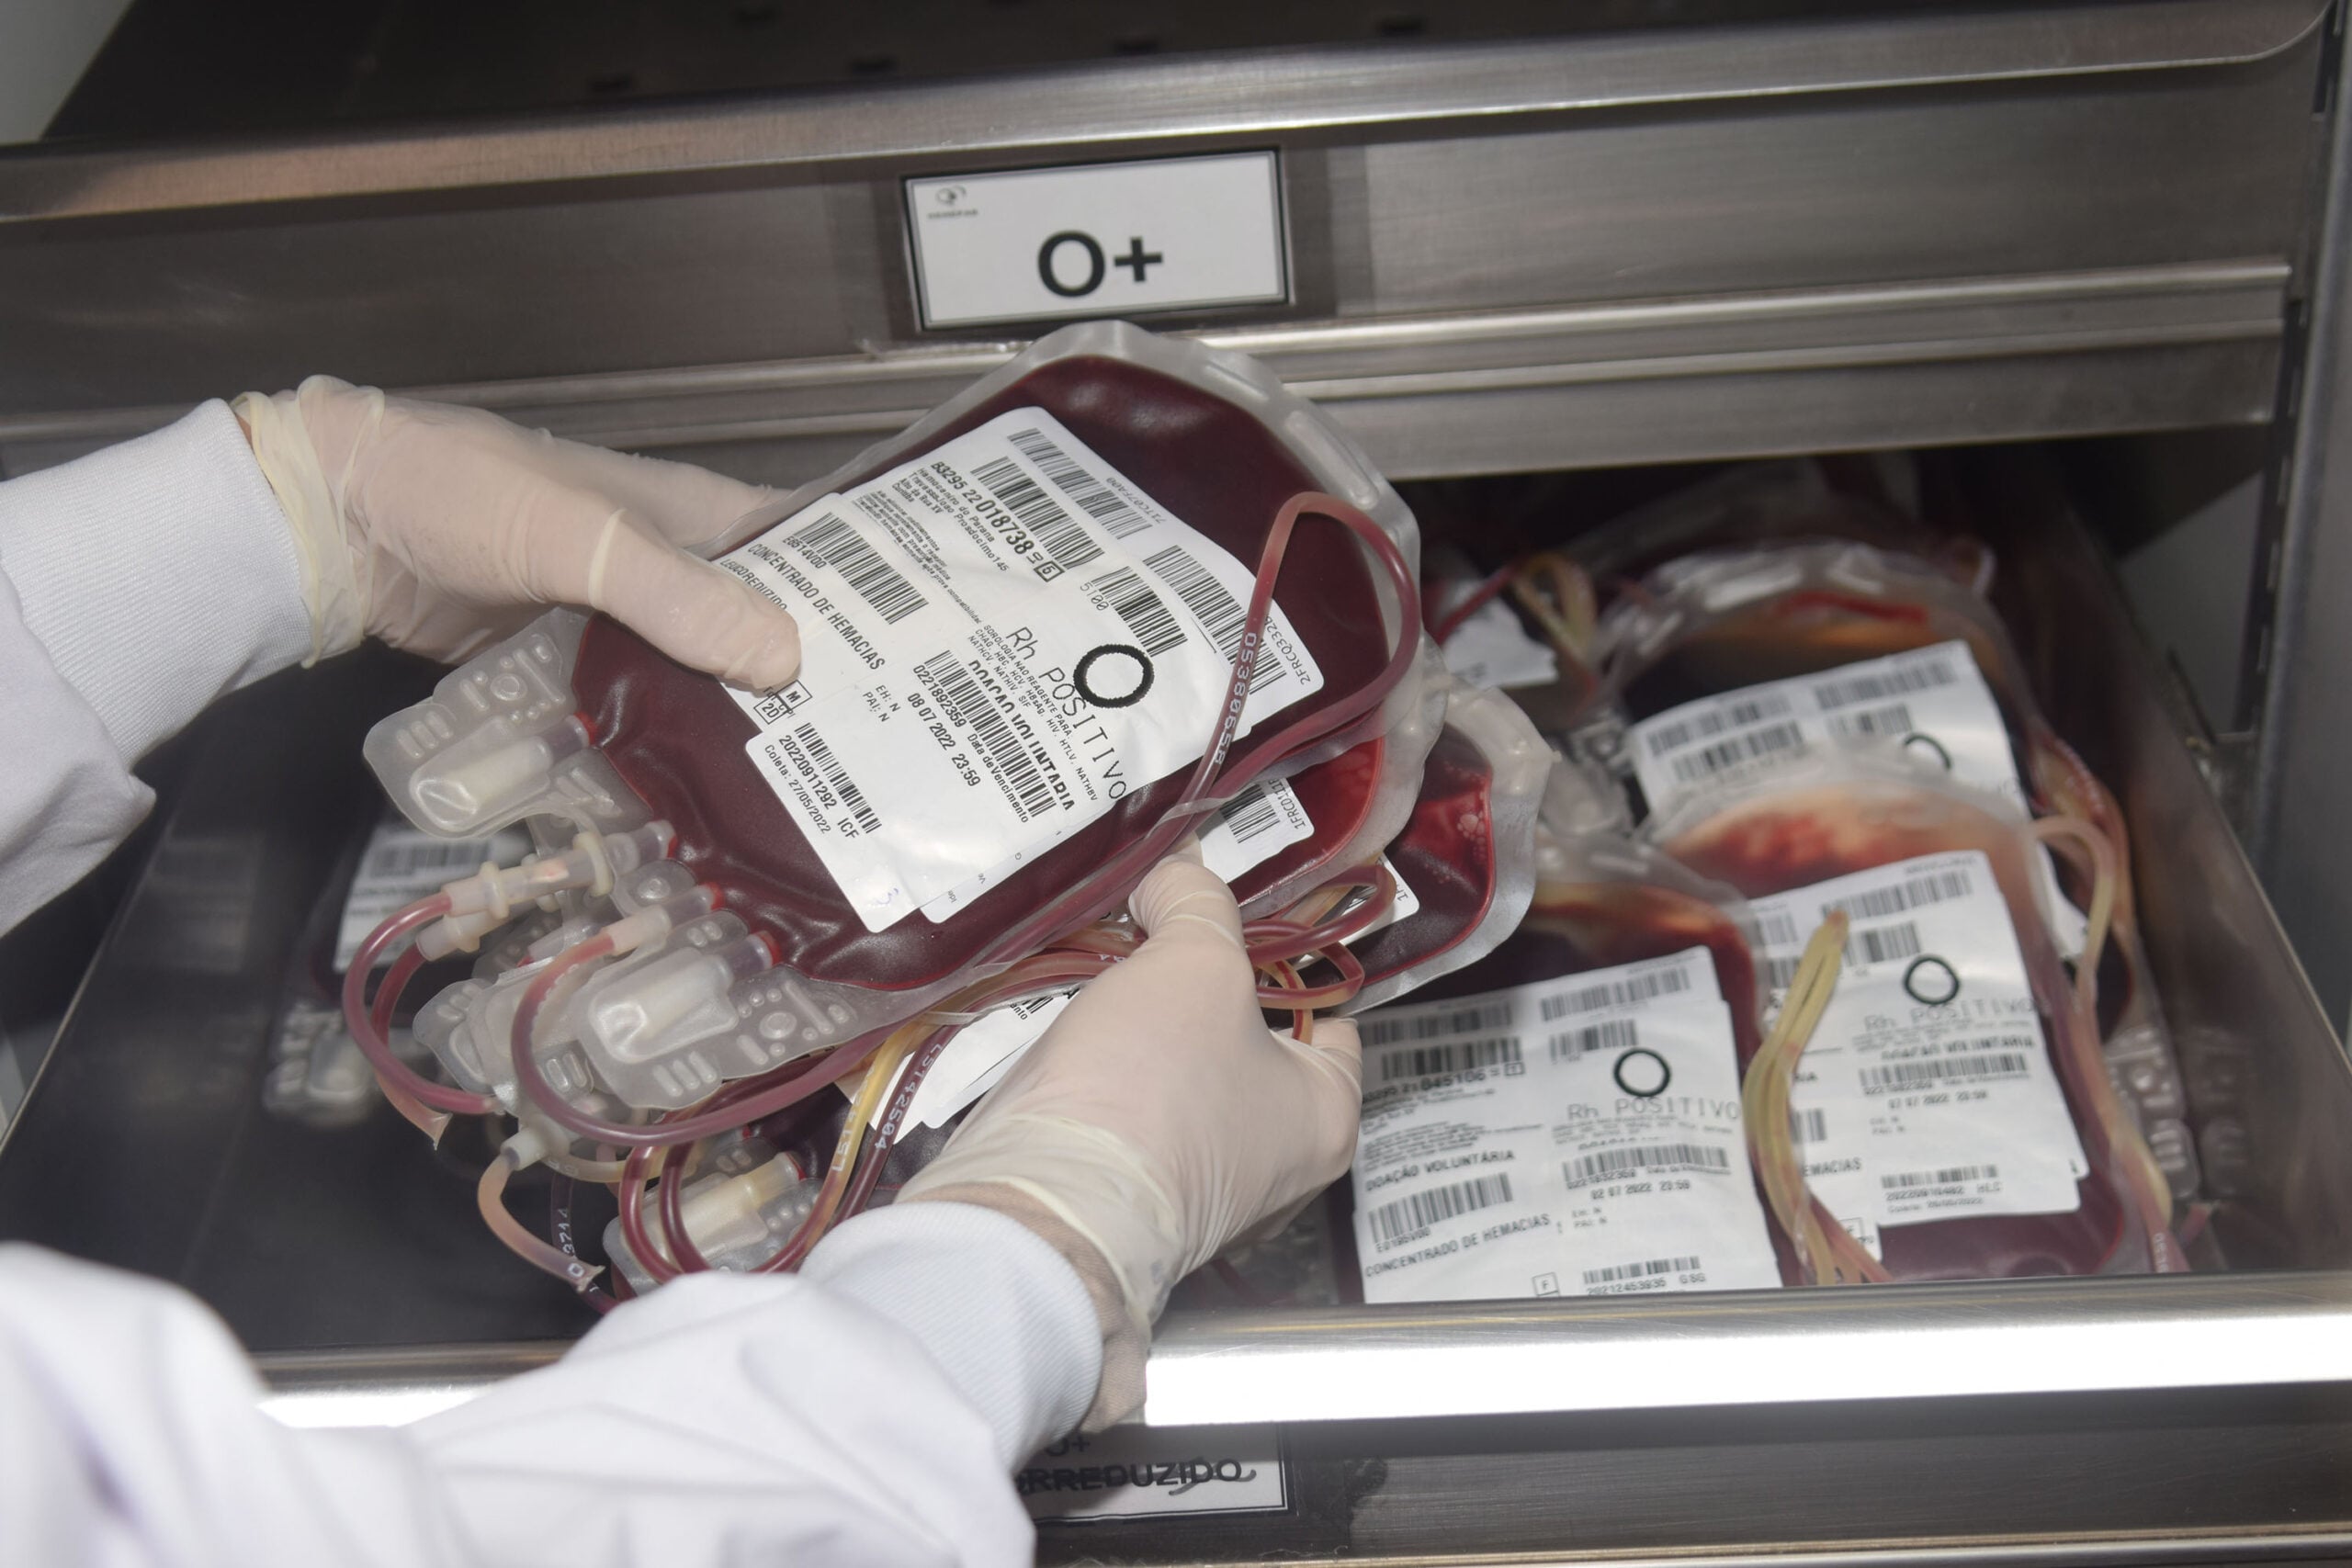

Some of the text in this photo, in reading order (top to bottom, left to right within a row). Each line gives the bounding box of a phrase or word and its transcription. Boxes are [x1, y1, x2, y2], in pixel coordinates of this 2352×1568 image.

[1037, 231, 1163, 297] O+
[957, 505, 971, 518] do
[975, 499, 1035, 555] 018738
[747, 543, 820, 599] CONCENTRADO
[811, 597, 835, 615] DE
[827, 612, 886, 671] HEMACIAS
[786, 690, 802, 704] M
[1073, 644, 1155, 709] O
[761, 699, 779, 721] 2D
[877, 712, 890, 723] N
[888, 702, 901, 713] N
[912, 664, 967, 728] 0221892359
[967, 733, 986, 756] Data
[1005, 626, 1126, 799] Rh POSITIVO
[907, 693, 981, 787] 08 07 2022 23:59
[764, 744, 831, 834] Coleta: 27/05/2022
[778, 734, 860, 839] 20220911292 ICF
[1904, 955, 1961, 1007] O
[1613, 1047, 1671, 1098] O
[1615, 1097, 1742, 1121] POSITIVO
[1365, 1213, 1551, 1278] CONCENTRADO DE HEMACIAS
[1018, 1458, 1242, 1496] RREDUZIDO
